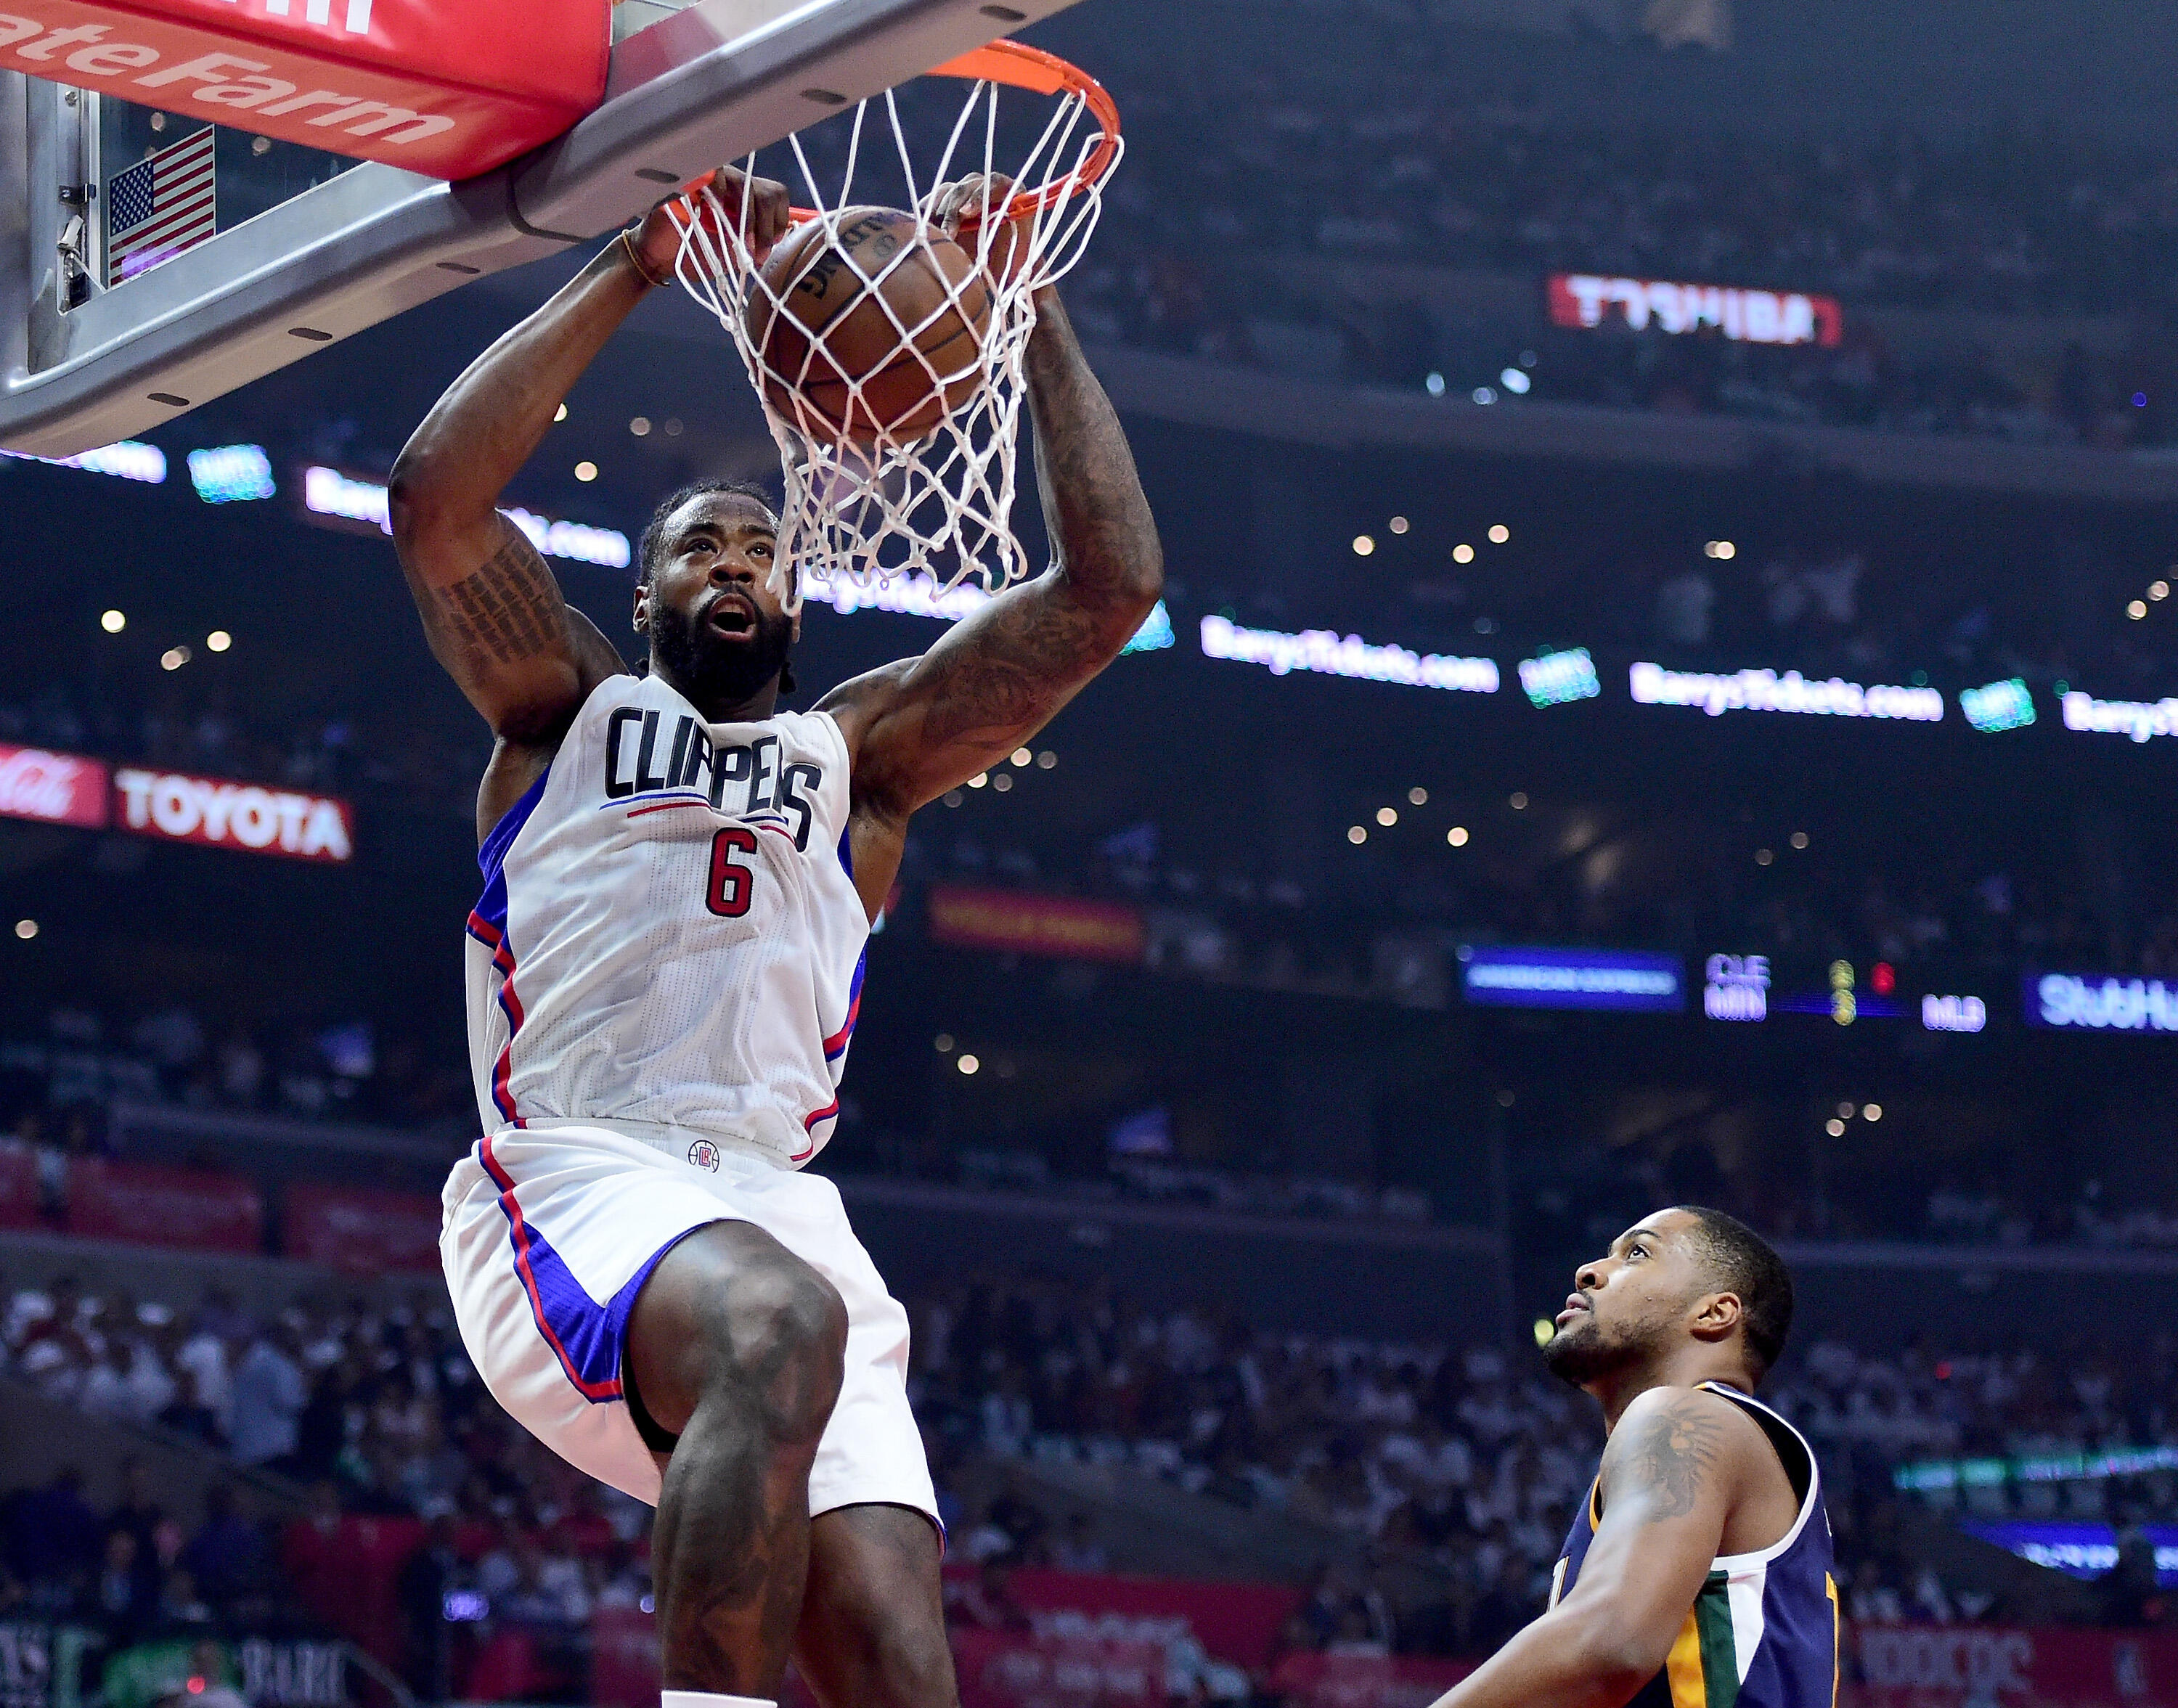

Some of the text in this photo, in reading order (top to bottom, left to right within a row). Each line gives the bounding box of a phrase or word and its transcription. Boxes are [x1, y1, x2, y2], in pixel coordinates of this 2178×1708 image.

[114, 768, 354, 861] TOYOTA
[605, 706, 823, 854] CLIPPES
[705, 826, 758, 919] 6
